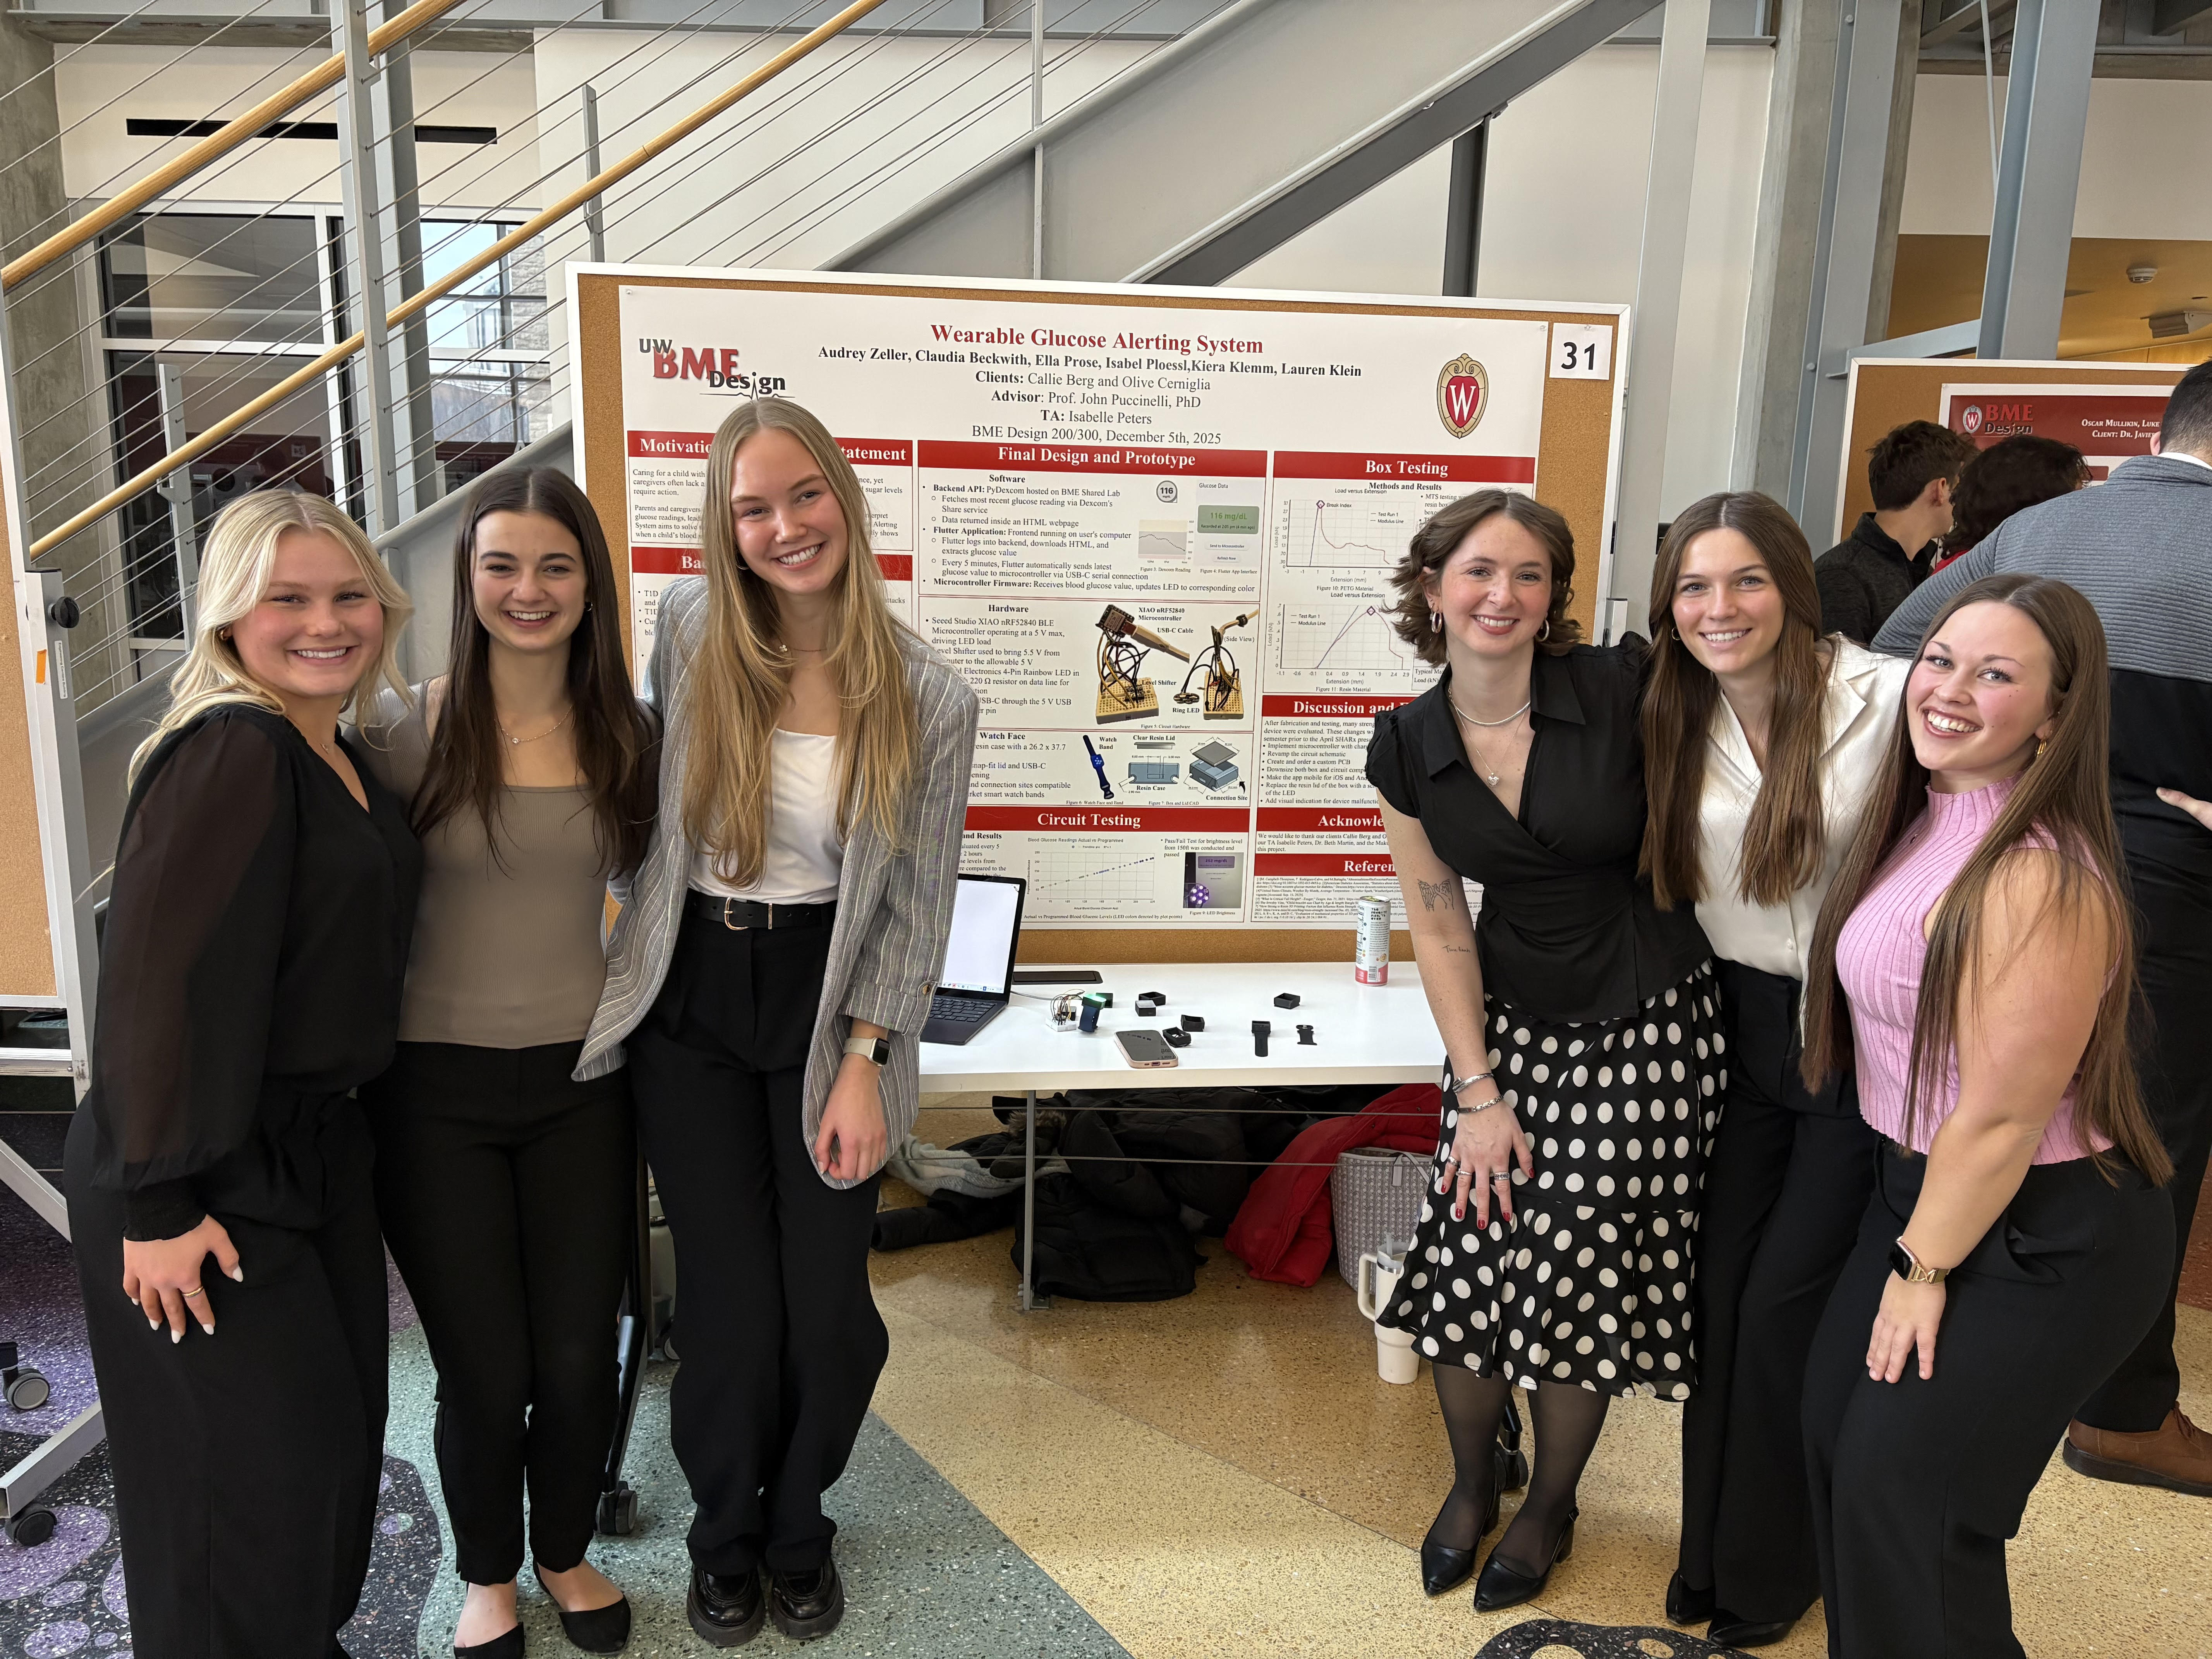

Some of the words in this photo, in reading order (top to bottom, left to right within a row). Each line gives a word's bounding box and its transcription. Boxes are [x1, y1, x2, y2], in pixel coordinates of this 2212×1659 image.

[639, 338, 672, 354] UW
[930, 325, 1025, 345] Wearable
[1031, 329, 1106, 348] Glucose
[1112, 332, 1191, 356] Alerting
[1197, 335, 1263, 357] System
[652, 346, 741, 380] BME
[818, 346, 866, 362] Audrey
[870, 348, 911, 363] Zeller,
[915, 350, 965, 362] Claudia
[969, 352, 1031, 368] Beckwith,
[1035, 354, 1060, 366] Ella
[1064, 356, 1101, 370] Prose,
[1106, 357, 1142, 369] Isabel
[1230, 361, 1277, 376] Klemm,
[1281, 363, 1325, 375] Lauren
[1329, 364, 1361, 376] Klein
[1561, 342, 1595, 370] 31
[709, 370, 786, 395] Design
[975, 371, 1023, 383] Clients:
[1028, 373, 1062, 385] Callie
[1066, 374, 1094, 389] Berg
[1098, 375, 1118, 387] and
[1122, 376, 1154, 388] Olive
[1158, 377, 1211, 392] Cerniglia
[991, 390, 1044, 403] Advisor:
[1048, 392, 1076, 404] Prof.
[1080, 393, 1107, 405] John
[1112, 394, 1171, 409] Puccinelli,
[1176, 396, 1200, 407] PhD
[1449, 383, 1477, 421] W
[1040, 409, 1064, 421] TA:
[1069, 410, 1113, 423] Isabelle
[1117, 412, 1152, 424] Peters
[1985, 404, 2033, 421] BME
[1968, 414, 1978, 428] W
[1985, 422, 2032, 434] Design
[972, 425, 1003, 437] BME
[1008, 426, 1048, 441] Design
[1052, 428, 1102, 443] 200/300,
[1106, 430, 1165, 443] December
[1168, 432, 1189, 445] 5th,
[1193, 432, 1221, 444] 2025
[640, 438, 712, 453] Motivatio
[841, 446, 907, 460] tatement
[998, 447, 1036, 460] Final
[1040, 448, 1088, 466] Design
[1094, 450, 1120, 464] and
[1125, 451, 1195, 469] Prototype
[633, 469, 654, 477] Caring
[1365, 460, 1392, 473] Box
[1397, 461, 1448, 478] Testing
[989, 474, 1025, 483] Software
[634, 488, 656, 496] require
[987, 486, 1024, 495] PyDexcom
[1225, 513, 1247, 521] mg/dL
[961, 527, 1006, 536] Application:
[1041, 530, 1066, 539] running
[989, 605, 1029, 613] Hardware
[1293, 701, 1364, 714] Discussion
[1037, 813, 1086, 825] Circuit
[1091, 814, 1141, 829] Testing
[1318, 815, 1384, 826] Acknowle
[1343, 860, 1395, 872] Referen
